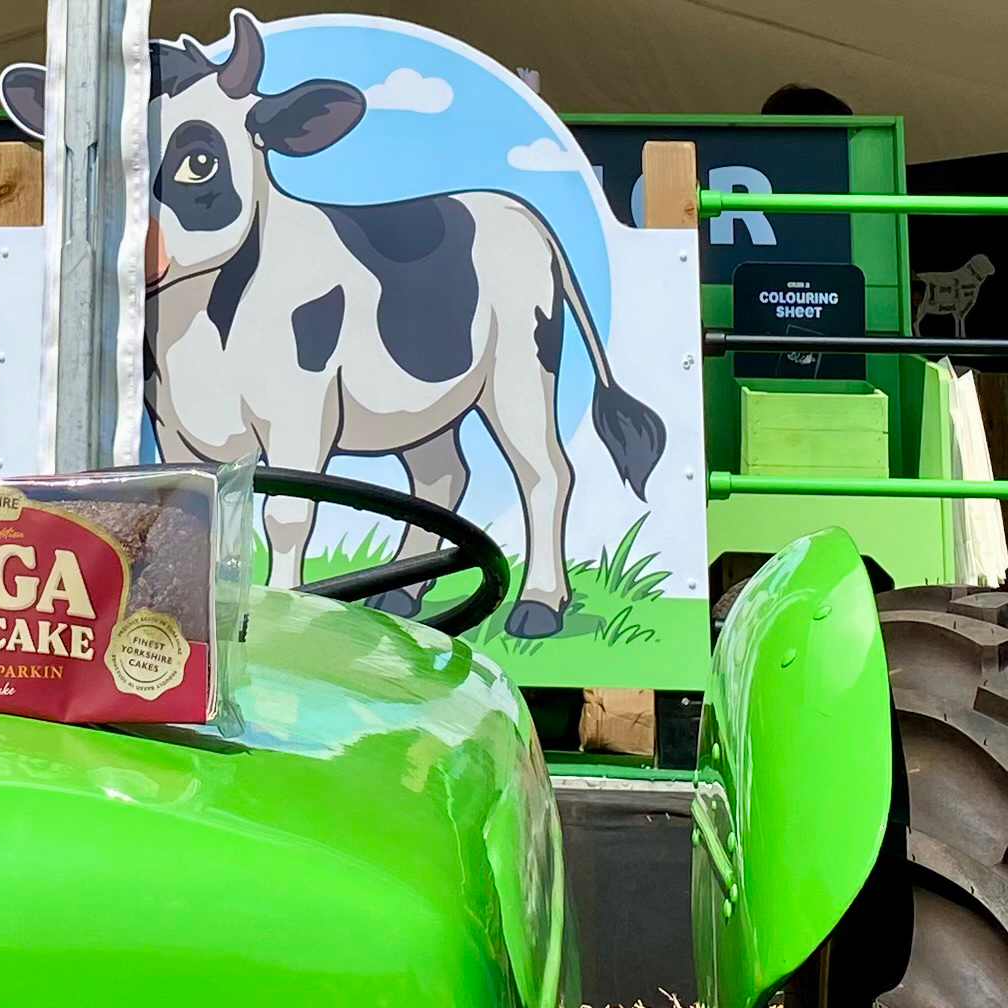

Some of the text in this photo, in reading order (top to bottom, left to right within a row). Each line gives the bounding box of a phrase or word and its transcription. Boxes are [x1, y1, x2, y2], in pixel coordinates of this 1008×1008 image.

[132, 636, 166, 651] FINEST
[121, 645, 172, 665] YORKSHIRE
[128, 658, 159, 673] CAKES
